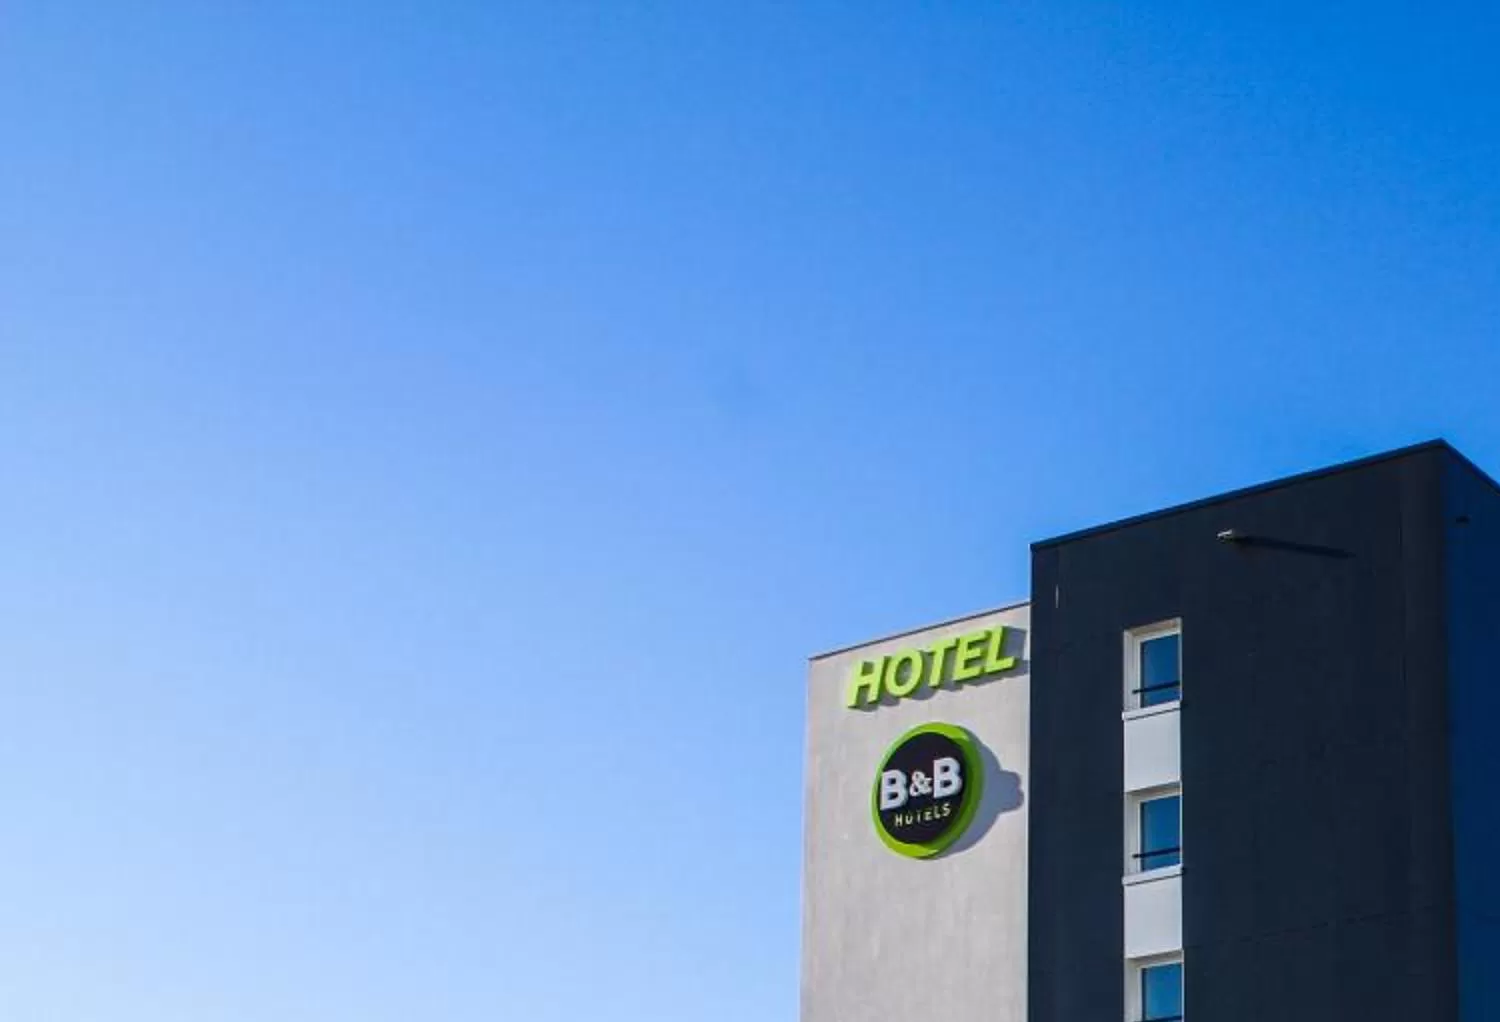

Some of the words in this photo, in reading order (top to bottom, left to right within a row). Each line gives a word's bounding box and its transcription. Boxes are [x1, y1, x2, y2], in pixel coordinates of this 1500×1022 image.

[848, 626, 1015, 708] HOTEL
[880, 757, 962, 811] B&B
[894, 802, 951, 827] HOTELS
